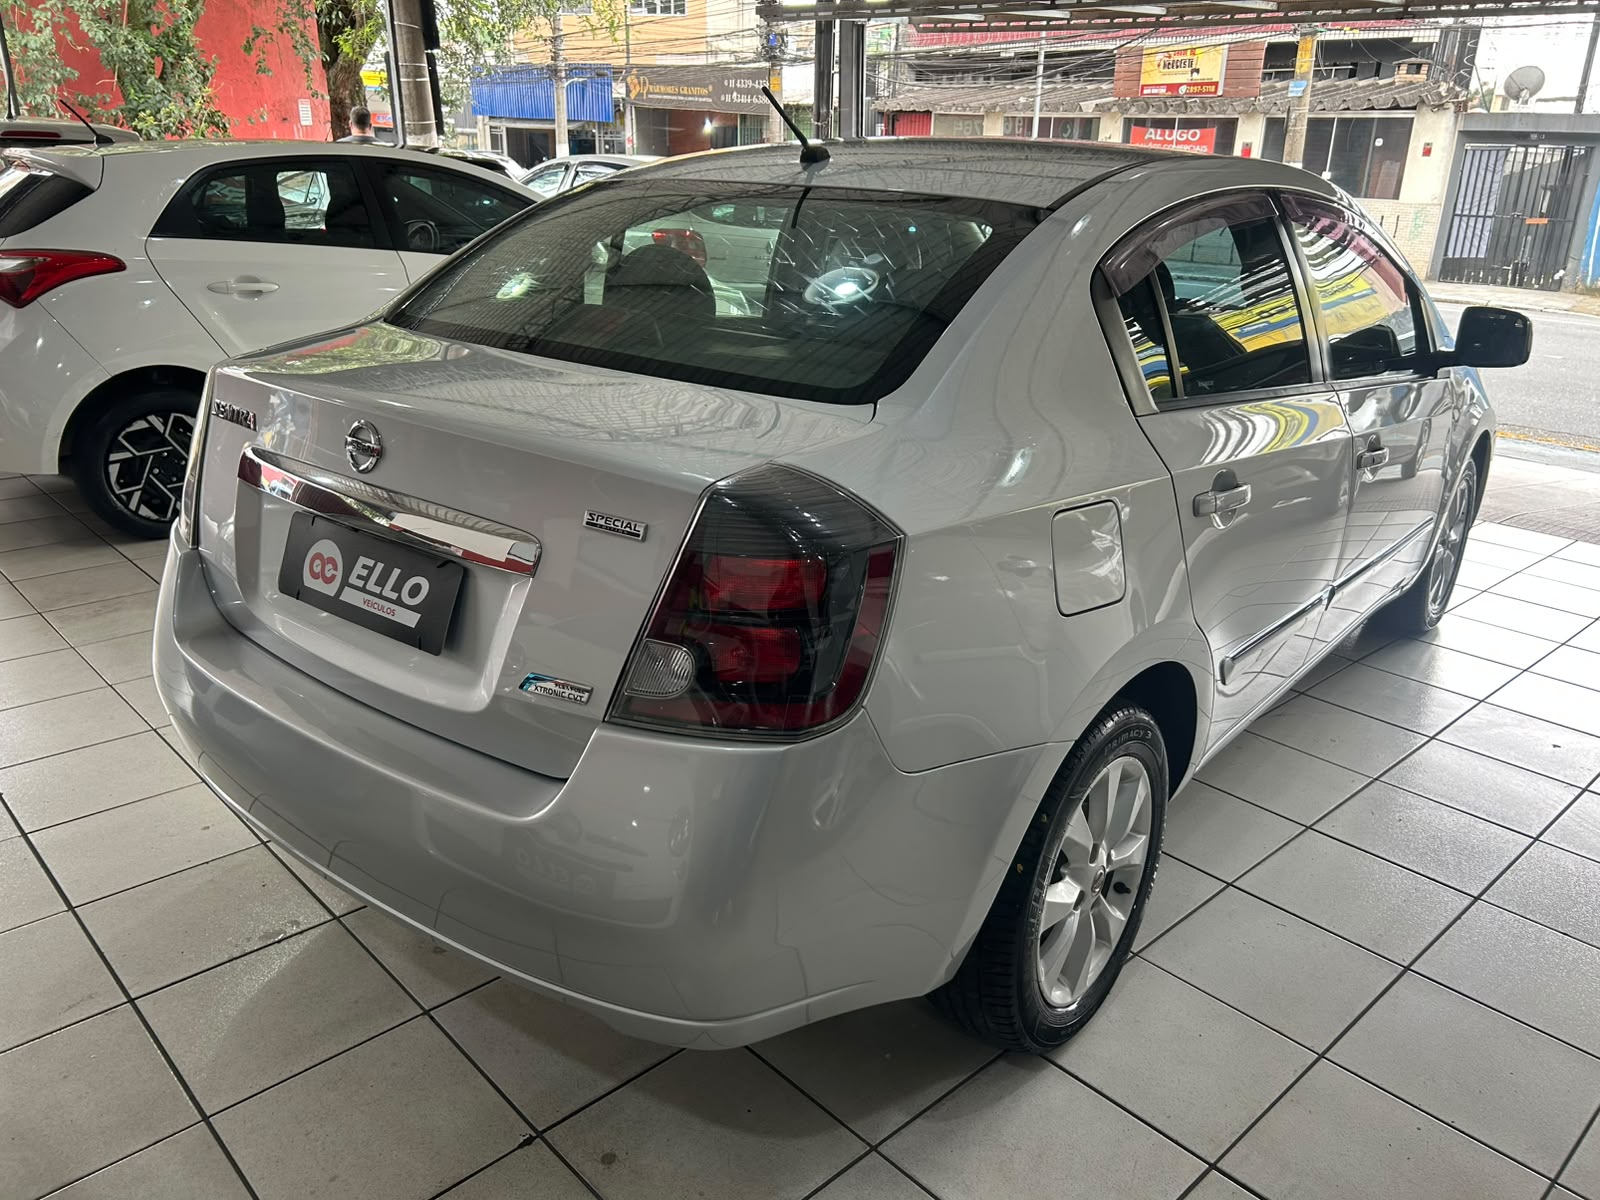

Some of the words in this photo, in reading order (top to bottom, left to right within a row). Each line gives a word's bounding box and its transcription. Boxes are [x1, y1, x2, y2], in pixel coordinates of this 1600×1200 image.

[679, 86, 709, 96] GRANITOS
[1144, 128, 1201, 141] ALUGO
[586, 511, 642, 533] SPECIAL
[348, 555, 431, 606] ELLO
[533, 684, 567, 699] XTRONIC
[1104, 729, 1145, 756] PRIMACY
[1145, 730, 1153, 740] 3
